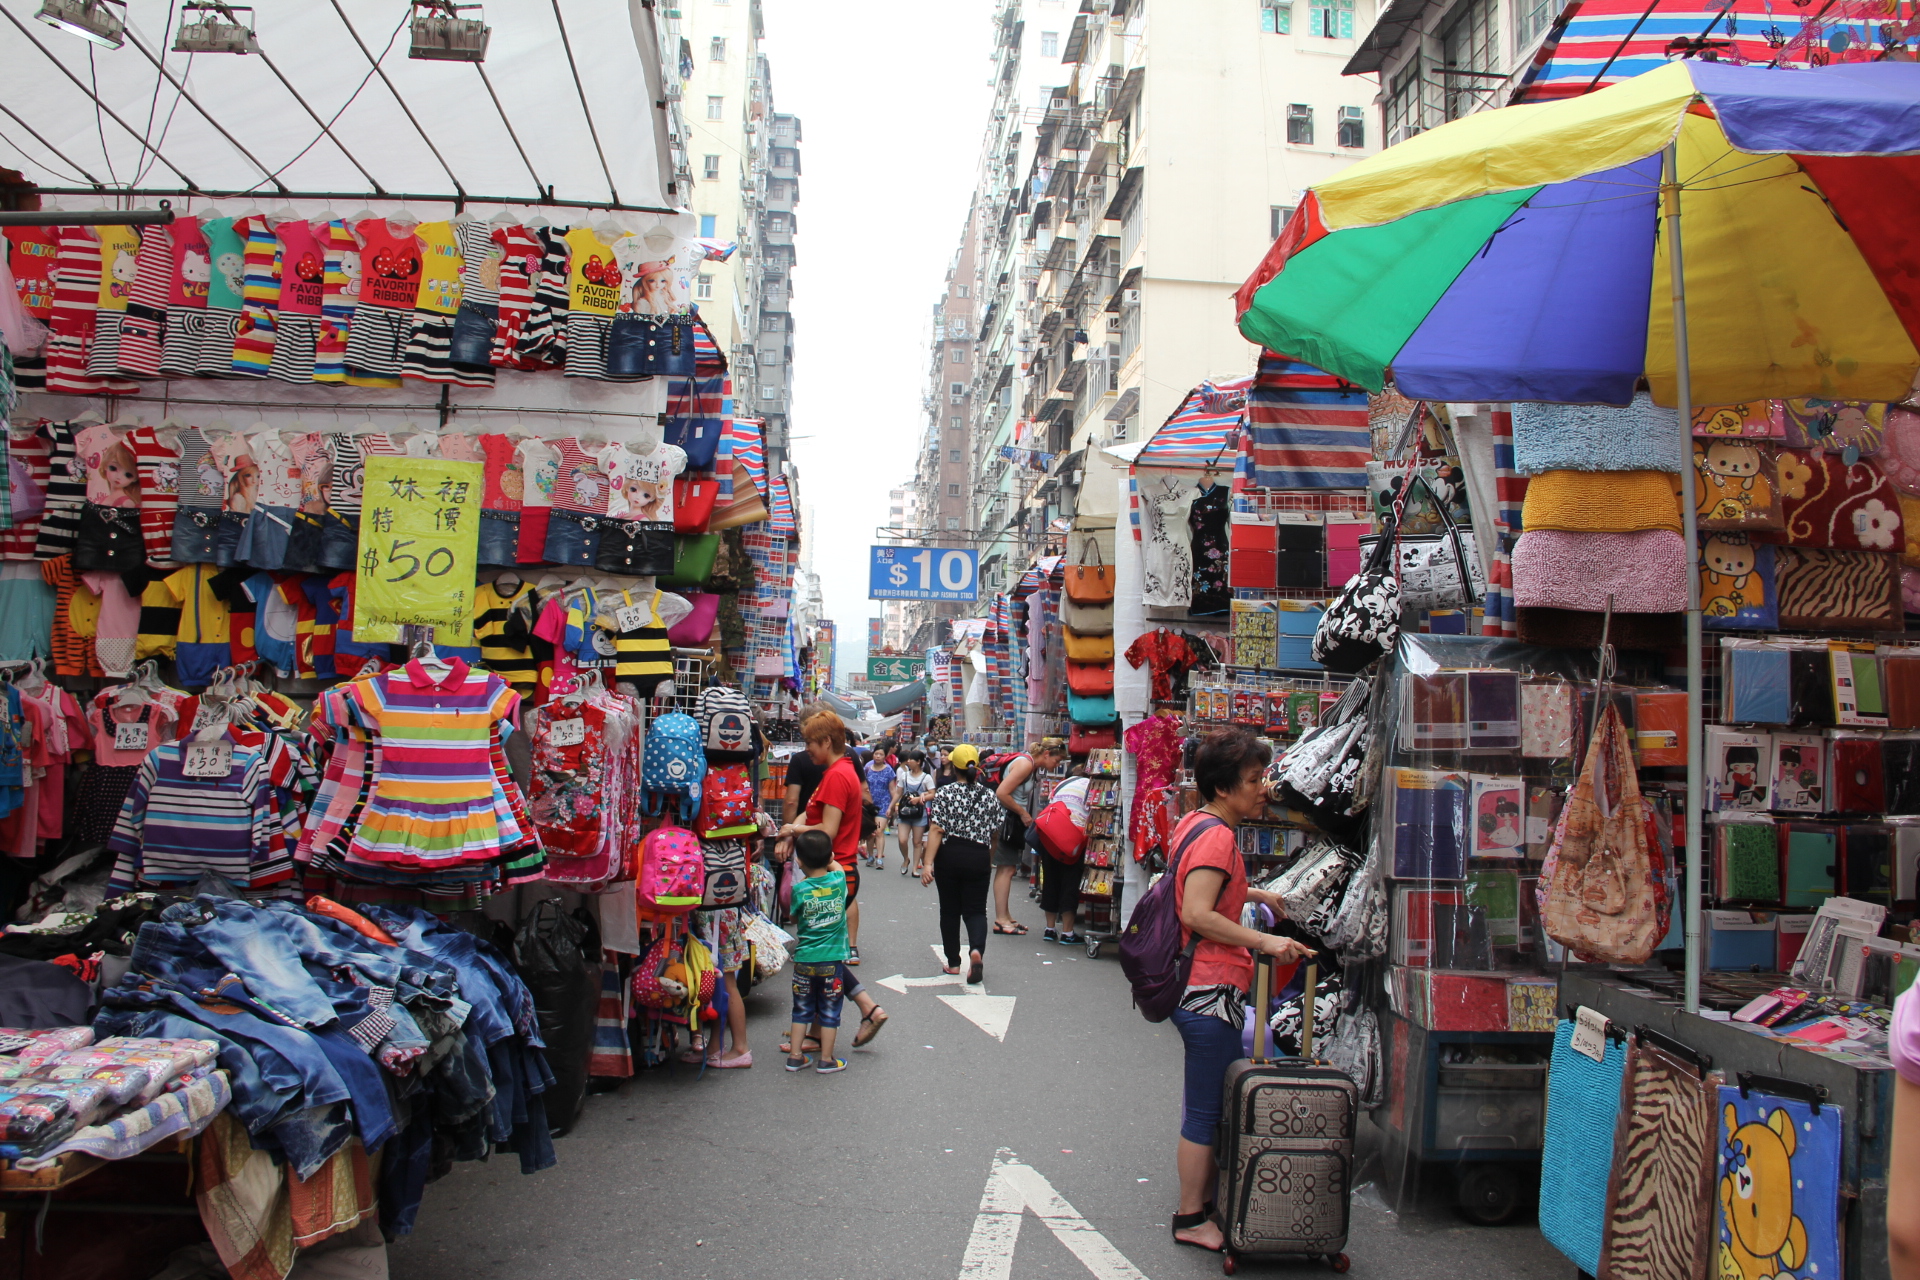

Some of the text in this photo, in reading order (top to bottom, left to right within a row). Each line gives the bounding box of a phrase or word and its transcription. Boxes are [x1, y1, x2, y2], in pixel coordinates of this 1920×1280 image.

[113, 242, 135, 250] Hello
[373, 289, 414, 303] RIBBON
[361, 539, 455, 583] $50
[889, 549, 973, 591] $10
[941, 591, 959, 599] FASHION
[960, 592, 974, 600] STOCK
[117, 734, 138, 744] $60
[189, 757, 217, 769] $50
